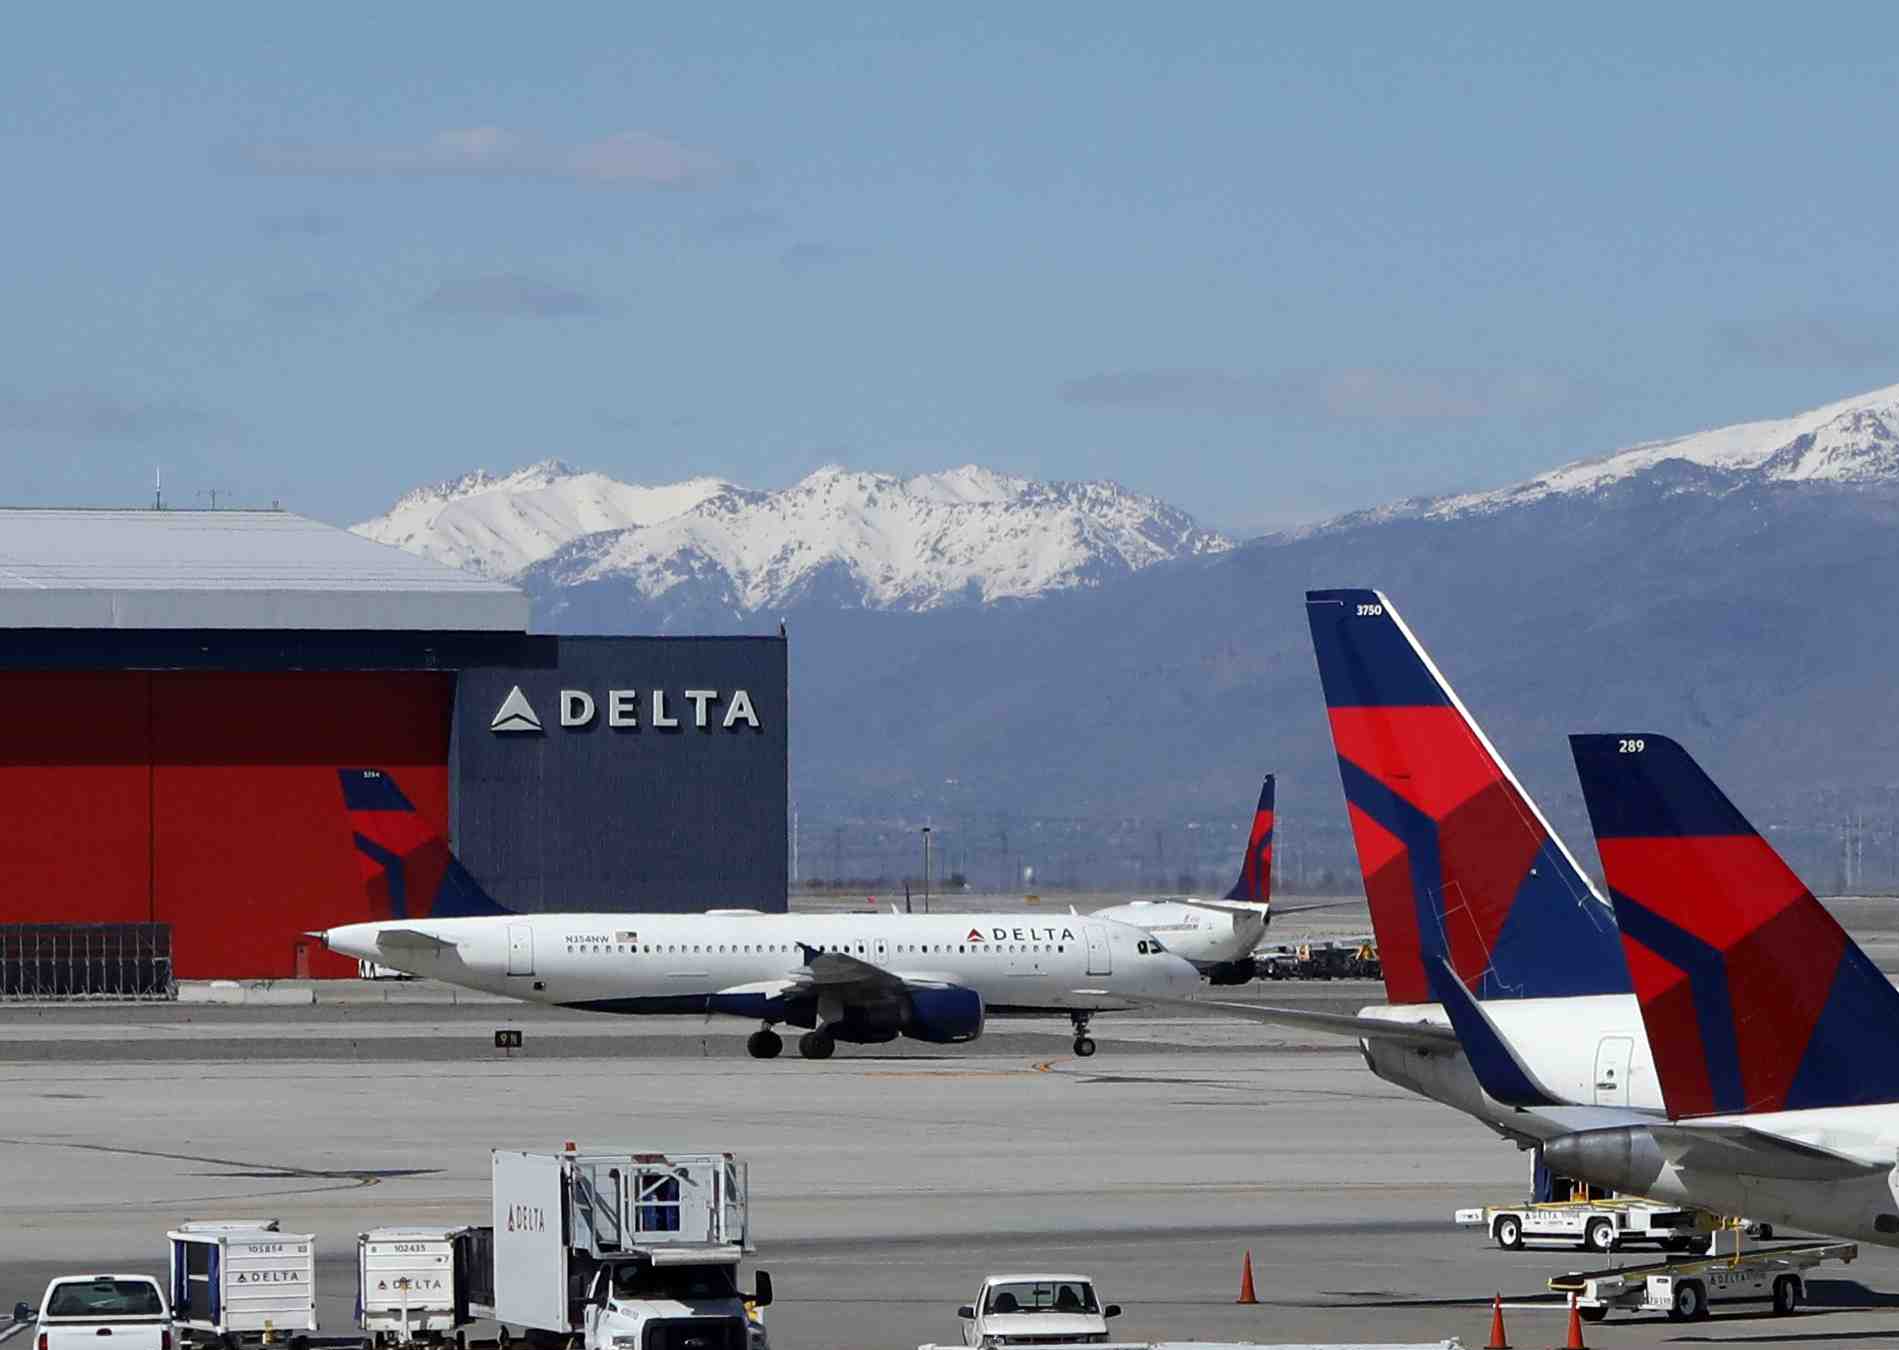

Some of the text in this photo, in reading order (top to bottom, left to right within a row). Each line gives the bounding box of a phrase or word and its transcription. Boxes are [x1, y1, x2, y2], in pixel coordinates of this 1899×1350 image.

[1356, 604, 1382, 616] 3750
[560, 689, 761, 727] DELTA
[1619, 739, 1645, 753] 289
[992, 927, 1075, 941] DELTA
[516, 1205, 545, 1233] DELTA
[252, 1272, 299, 1282] DELTA
